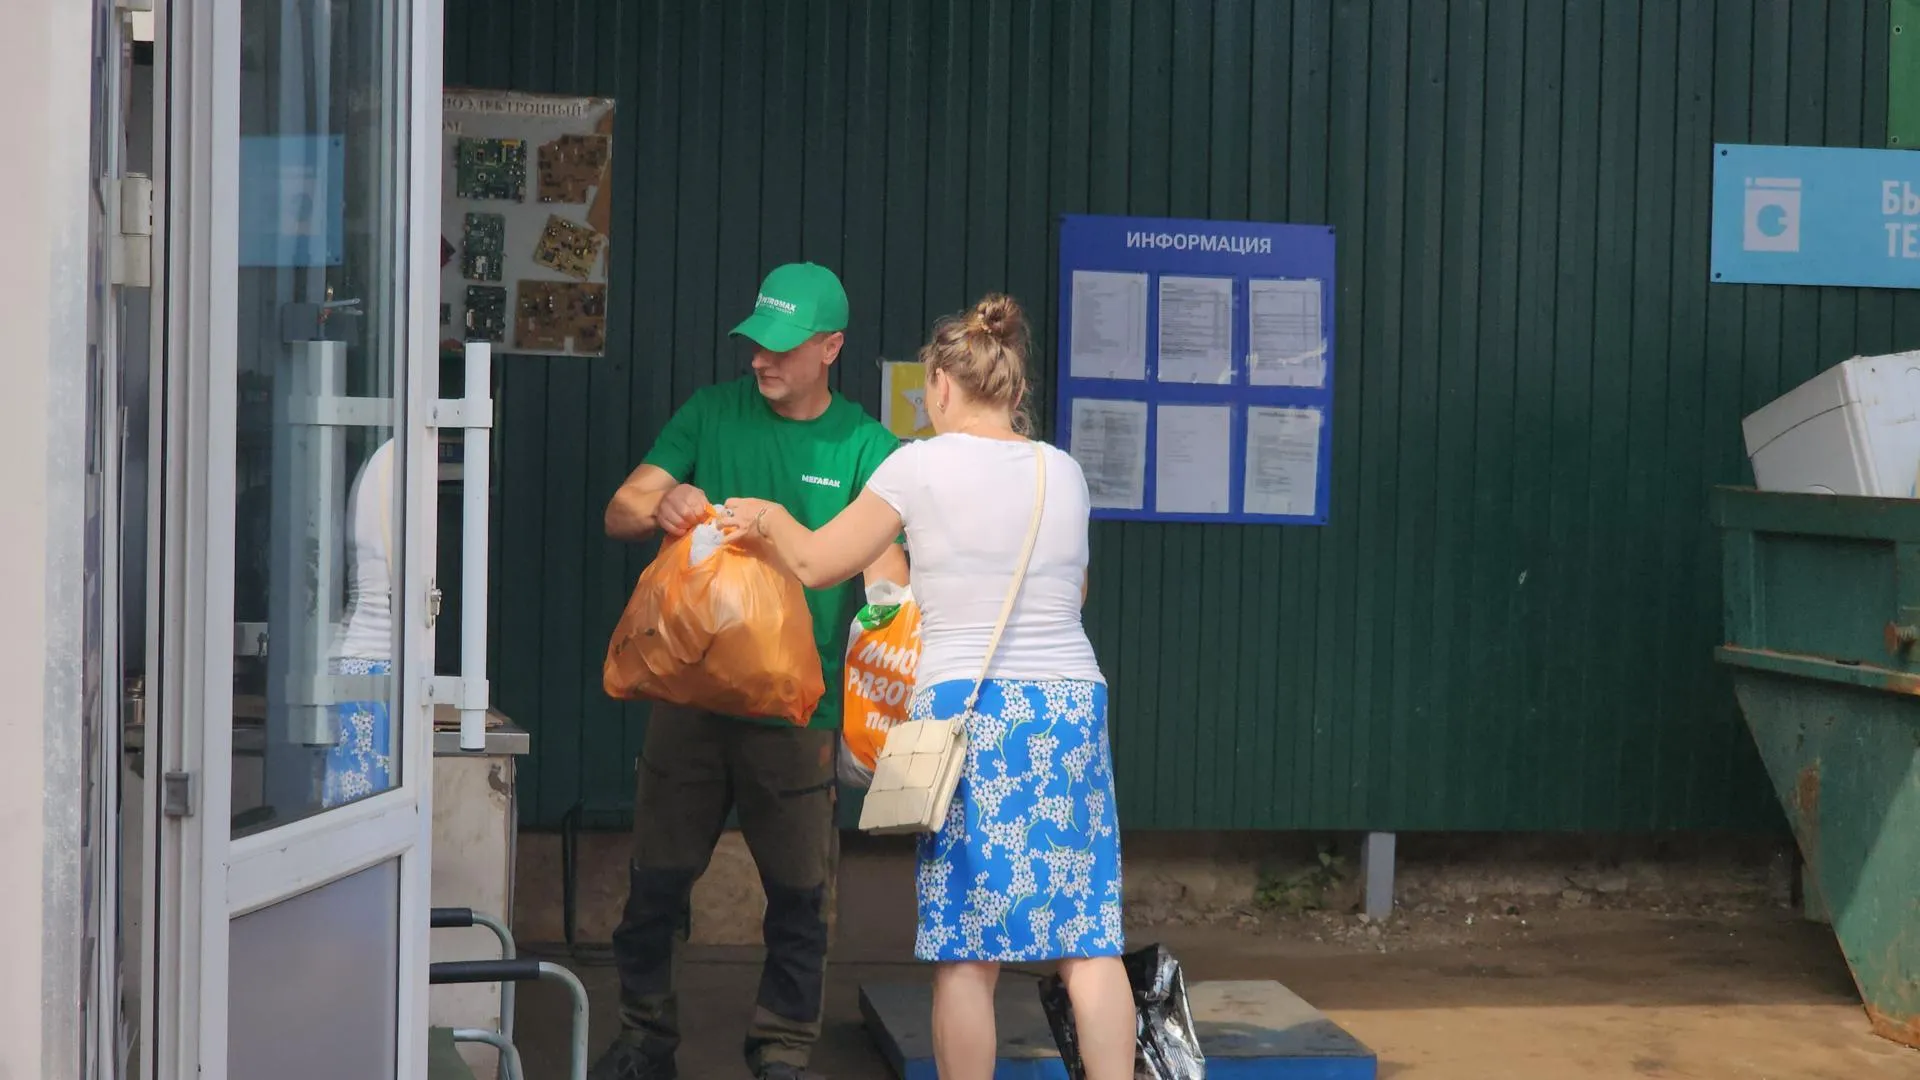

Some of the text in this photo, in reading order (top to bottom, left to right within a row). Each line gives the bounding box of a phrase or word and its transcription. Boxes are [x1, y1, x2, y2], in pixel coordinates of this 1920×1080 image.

[442, 120, 460, 133] М
[1127, 231, 1272, 254] ИНФОРМАЦИЯ
[1884, 223, 1920, 258] ТЕ
[858, 640, 918, 676] МНО
